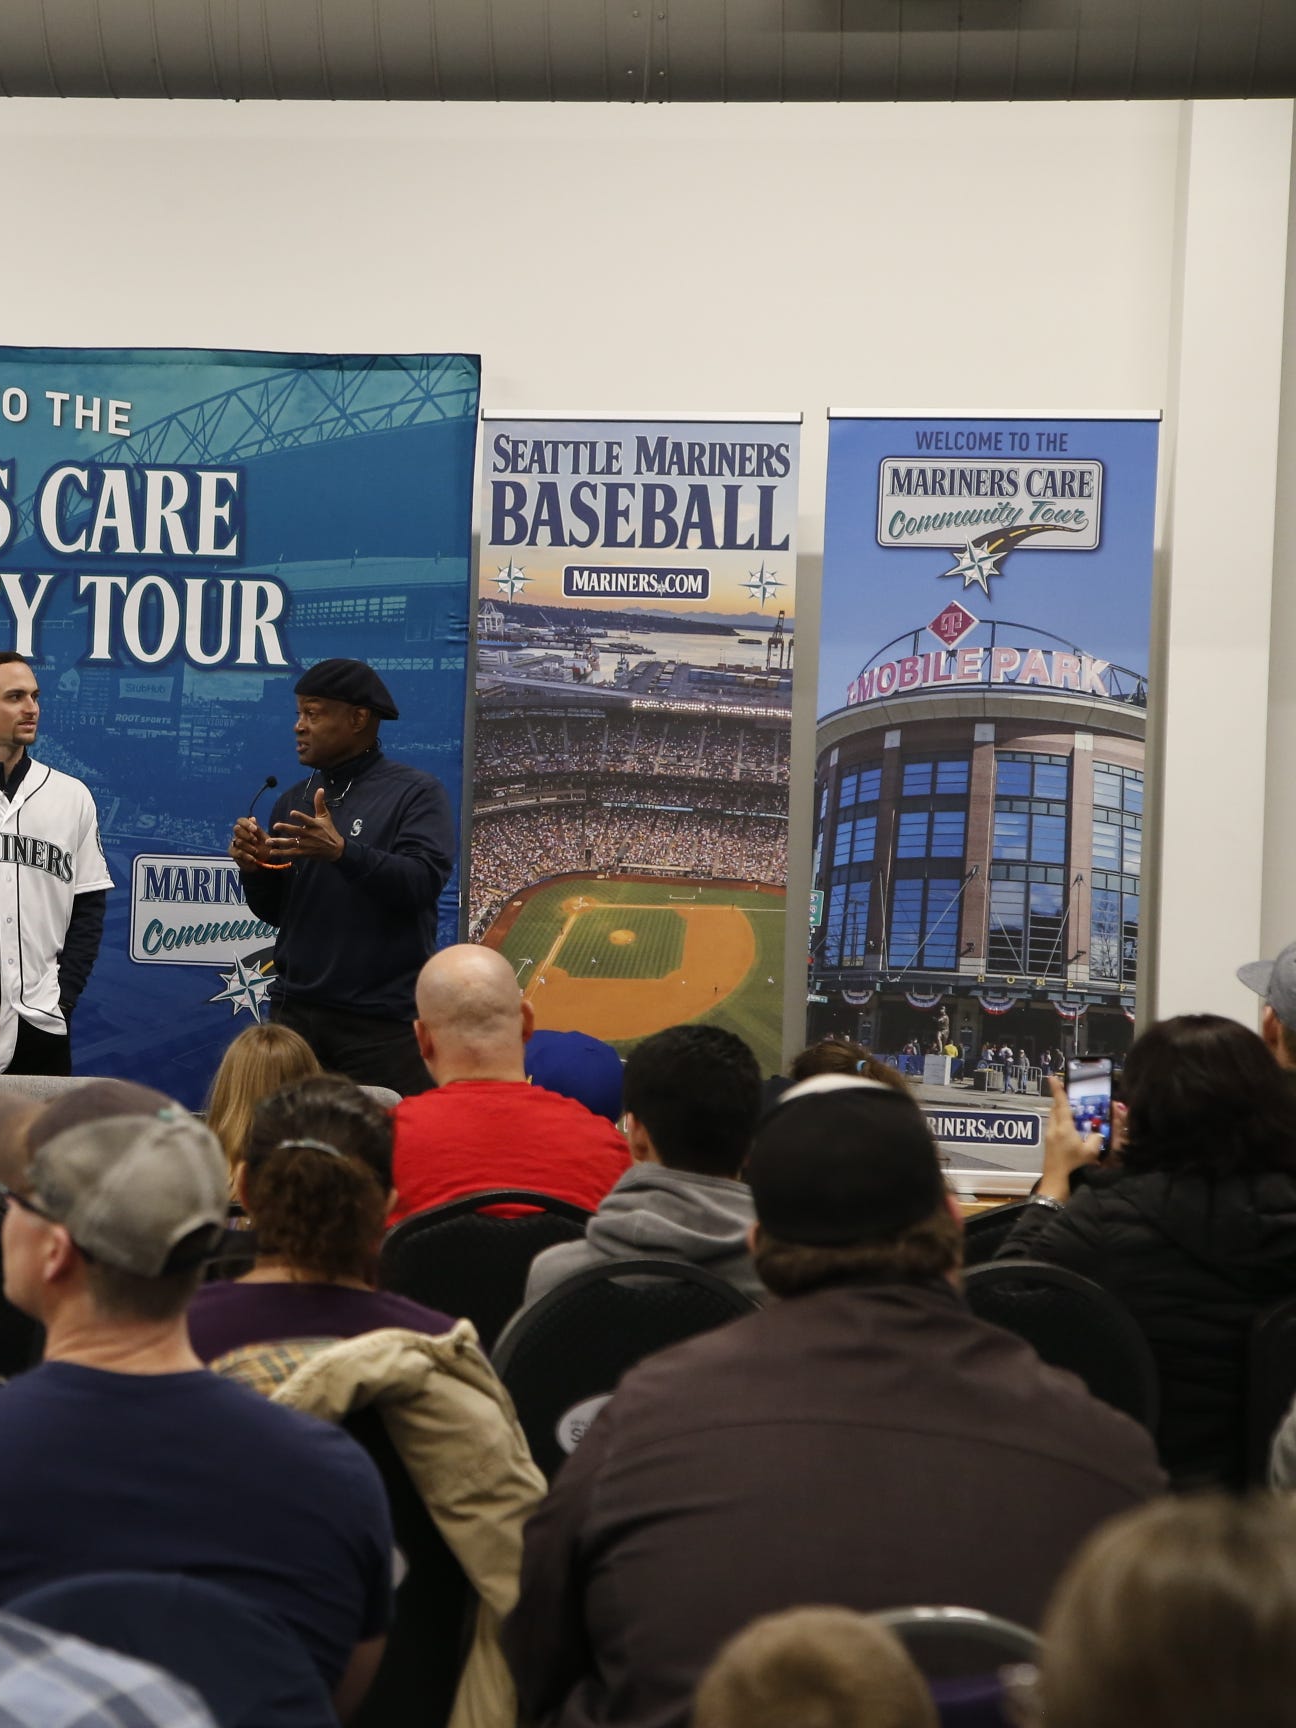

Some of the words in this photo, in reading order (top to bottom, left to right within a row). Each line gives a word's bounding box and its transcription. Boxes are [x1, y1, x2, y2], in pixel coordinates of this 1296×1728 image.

[45, 391, 132, 437] THE
[493, 433, 623, 475] SEATTLE
[633, 435, 791, 478] MARINERS
[915, 431, 1003, 450] WELCOME
[1009, 432, 1030, 451] TO
[1036, 432, 1069, 452] THE
[886, 466, 1020, 498] MARINERS
[1026, 468, 1094, 500] CARE
[39, 465, 241, 557] CARE
[488, 480, 790, 551] BASEBALL
[889, 501, 1023, 539] Community
[1029, 500, 1087, 525] Tour
[78, 571, 289, 667] TOUR
[992, 647, 1109, 697] PARK
